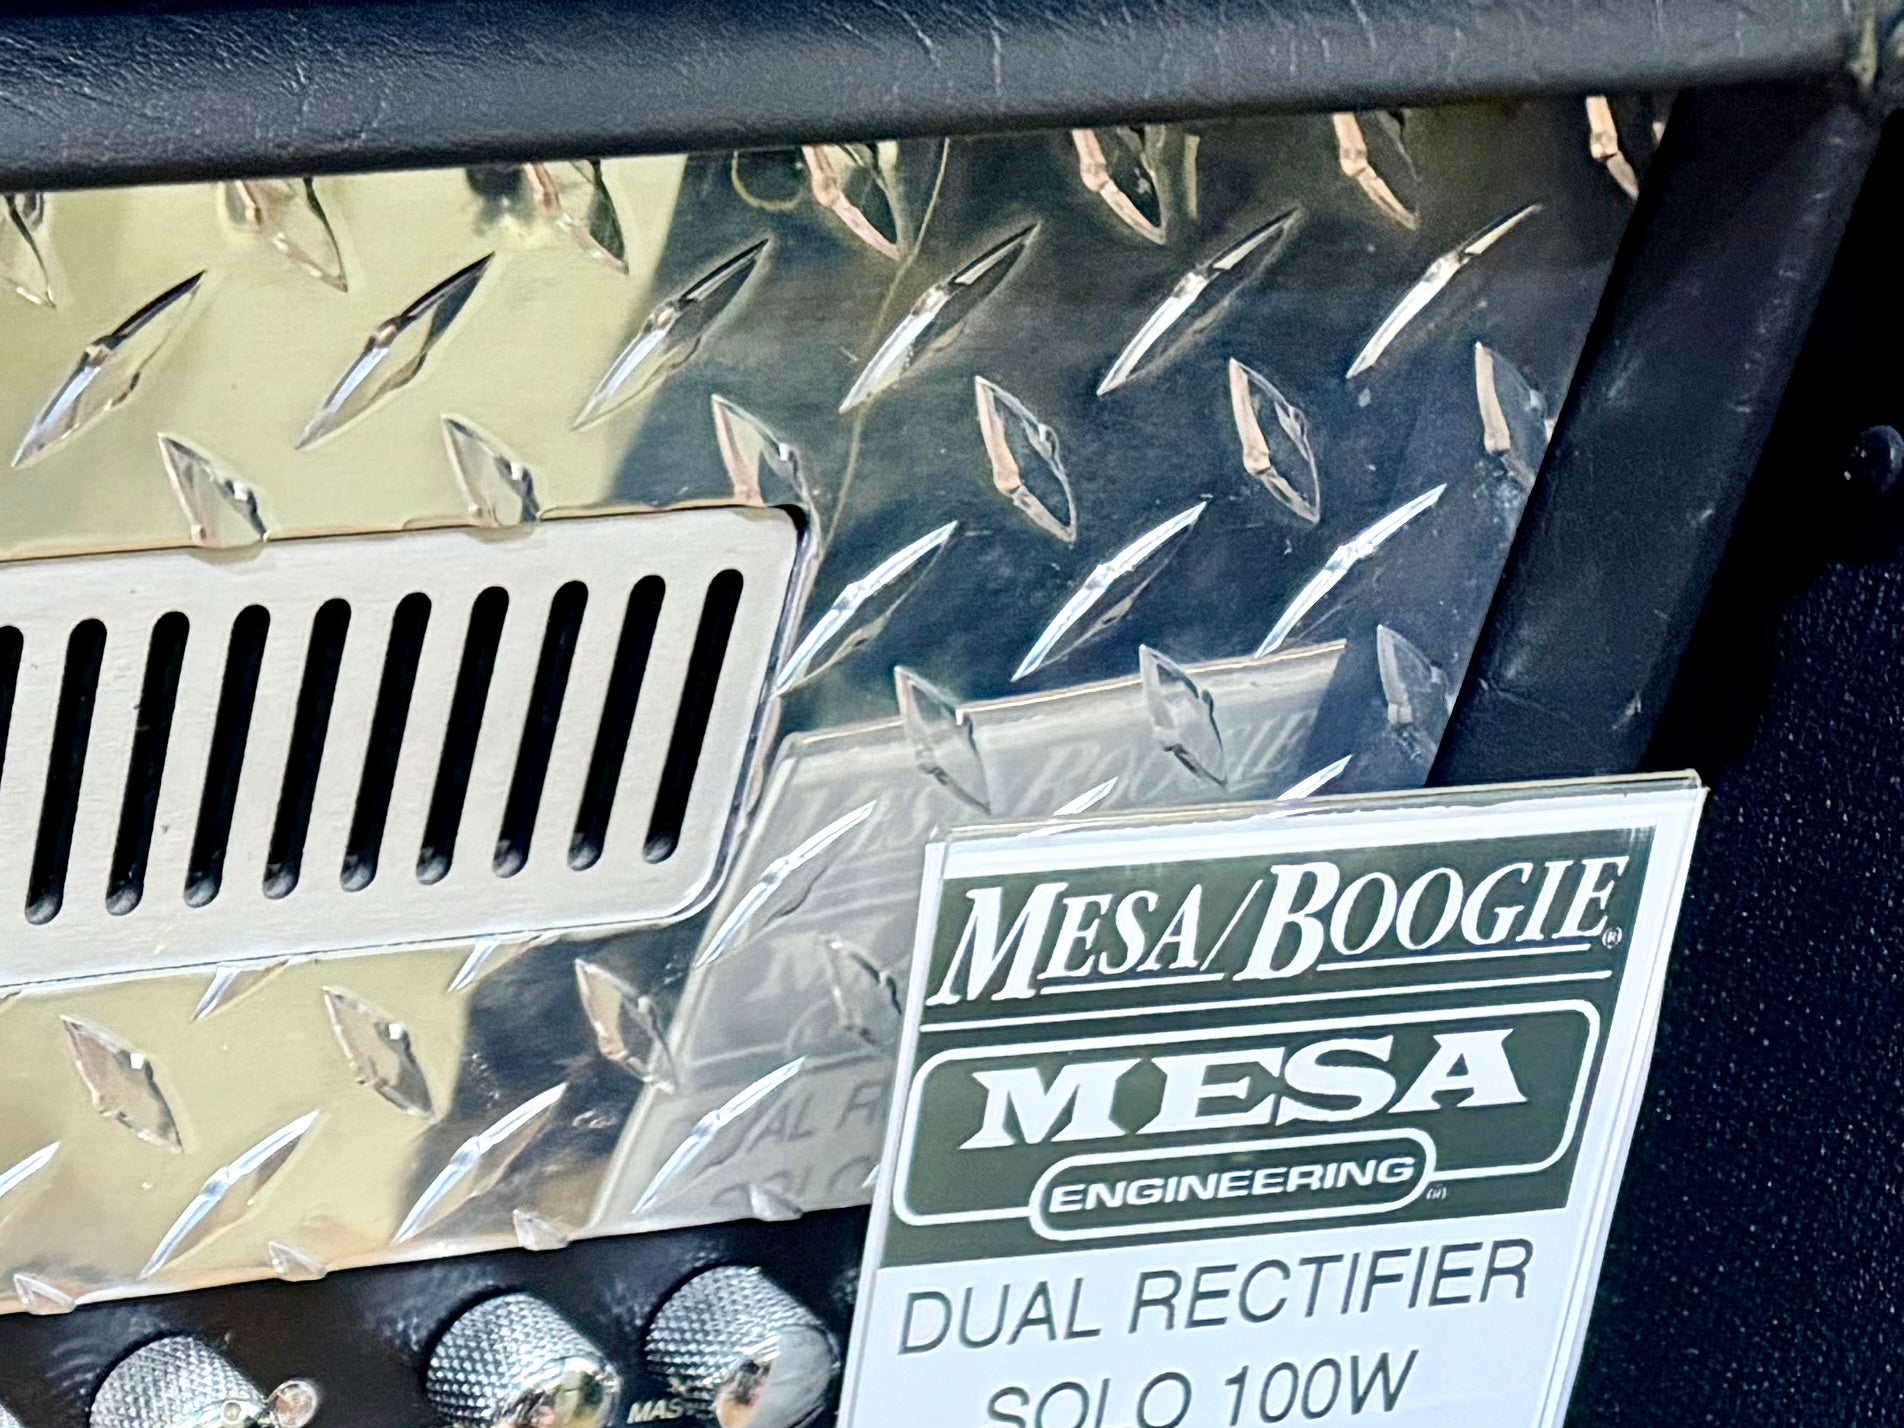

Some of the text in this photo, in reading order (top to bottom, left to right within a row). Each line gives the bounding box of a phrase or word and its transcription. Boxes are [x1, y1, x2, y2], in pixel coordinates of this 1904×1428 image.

[959, 1027, 1527, 1150] MESA
[1048, 1155, 1416, 1213] ENGINEERING
[898, 1238, 1535, 1355] DUAL RECTIFIER
[1223, 1349, 1419, 1427] 100W
